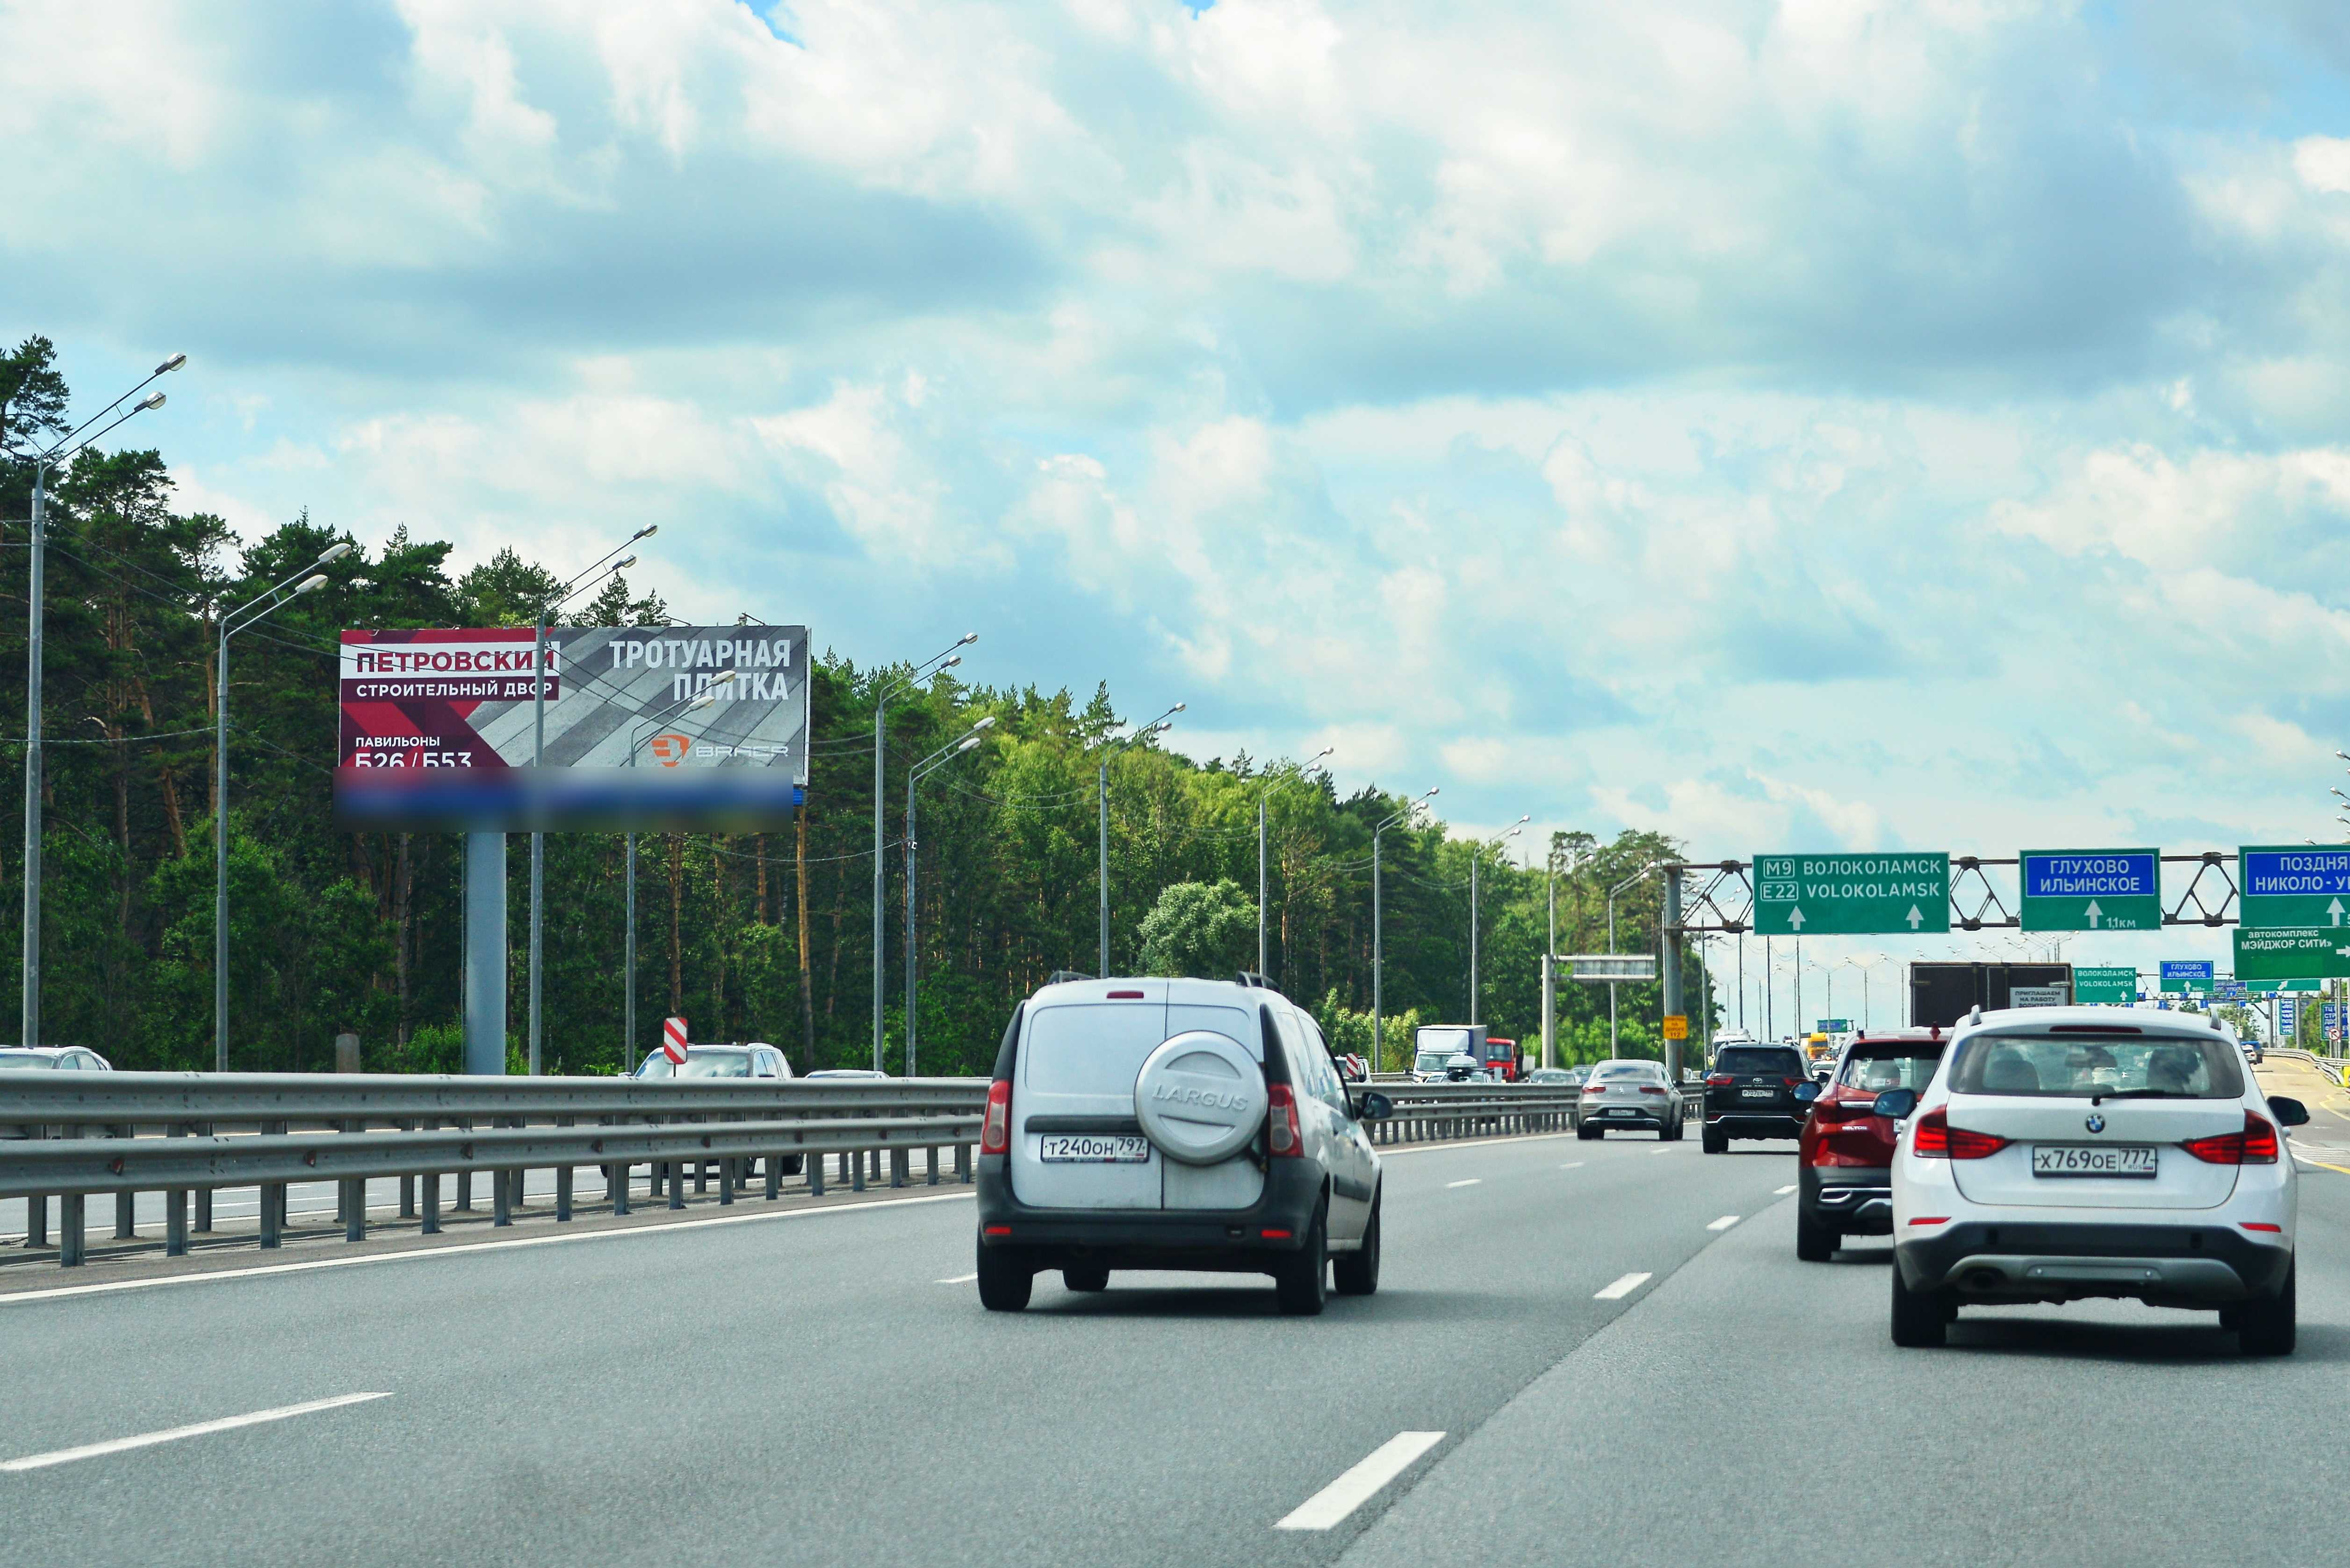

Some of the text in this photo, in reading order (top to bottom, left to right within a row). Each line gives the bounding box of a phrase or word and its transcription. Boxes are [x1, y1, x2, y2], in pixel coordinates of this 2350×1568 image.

[609, 639, 791, 668] ТРОТУАРНАЯ
[356, 680, 498, 697] СТРОИТЕЛЬНЫЙ
[674, 672, 789, 701] ПЛИТКА
[356, 736, 440, 747] ПАВИЛЬОНЫ
[696, 746, 789, 757] BRAER
[1803, 860, 1941, 876] ВОЛОКОЛАМСК
[2050, 860, 2129, 874] ГЛУХОВО
[2280, 856, 2350, 872] ПОЗДНЯ
[1763, 883, 1940, 899] E22 VOLOKOLAMSK
[2040, 877, 2140, 892] ИЛЬИНСКОЕ
[2248, 930, 2319, 939] автокомплекс
[2241, 939, 2332, 950] МЭЙДЖОР СИТИ»
[1152, 1084, 1248, 1111] LARGUS
